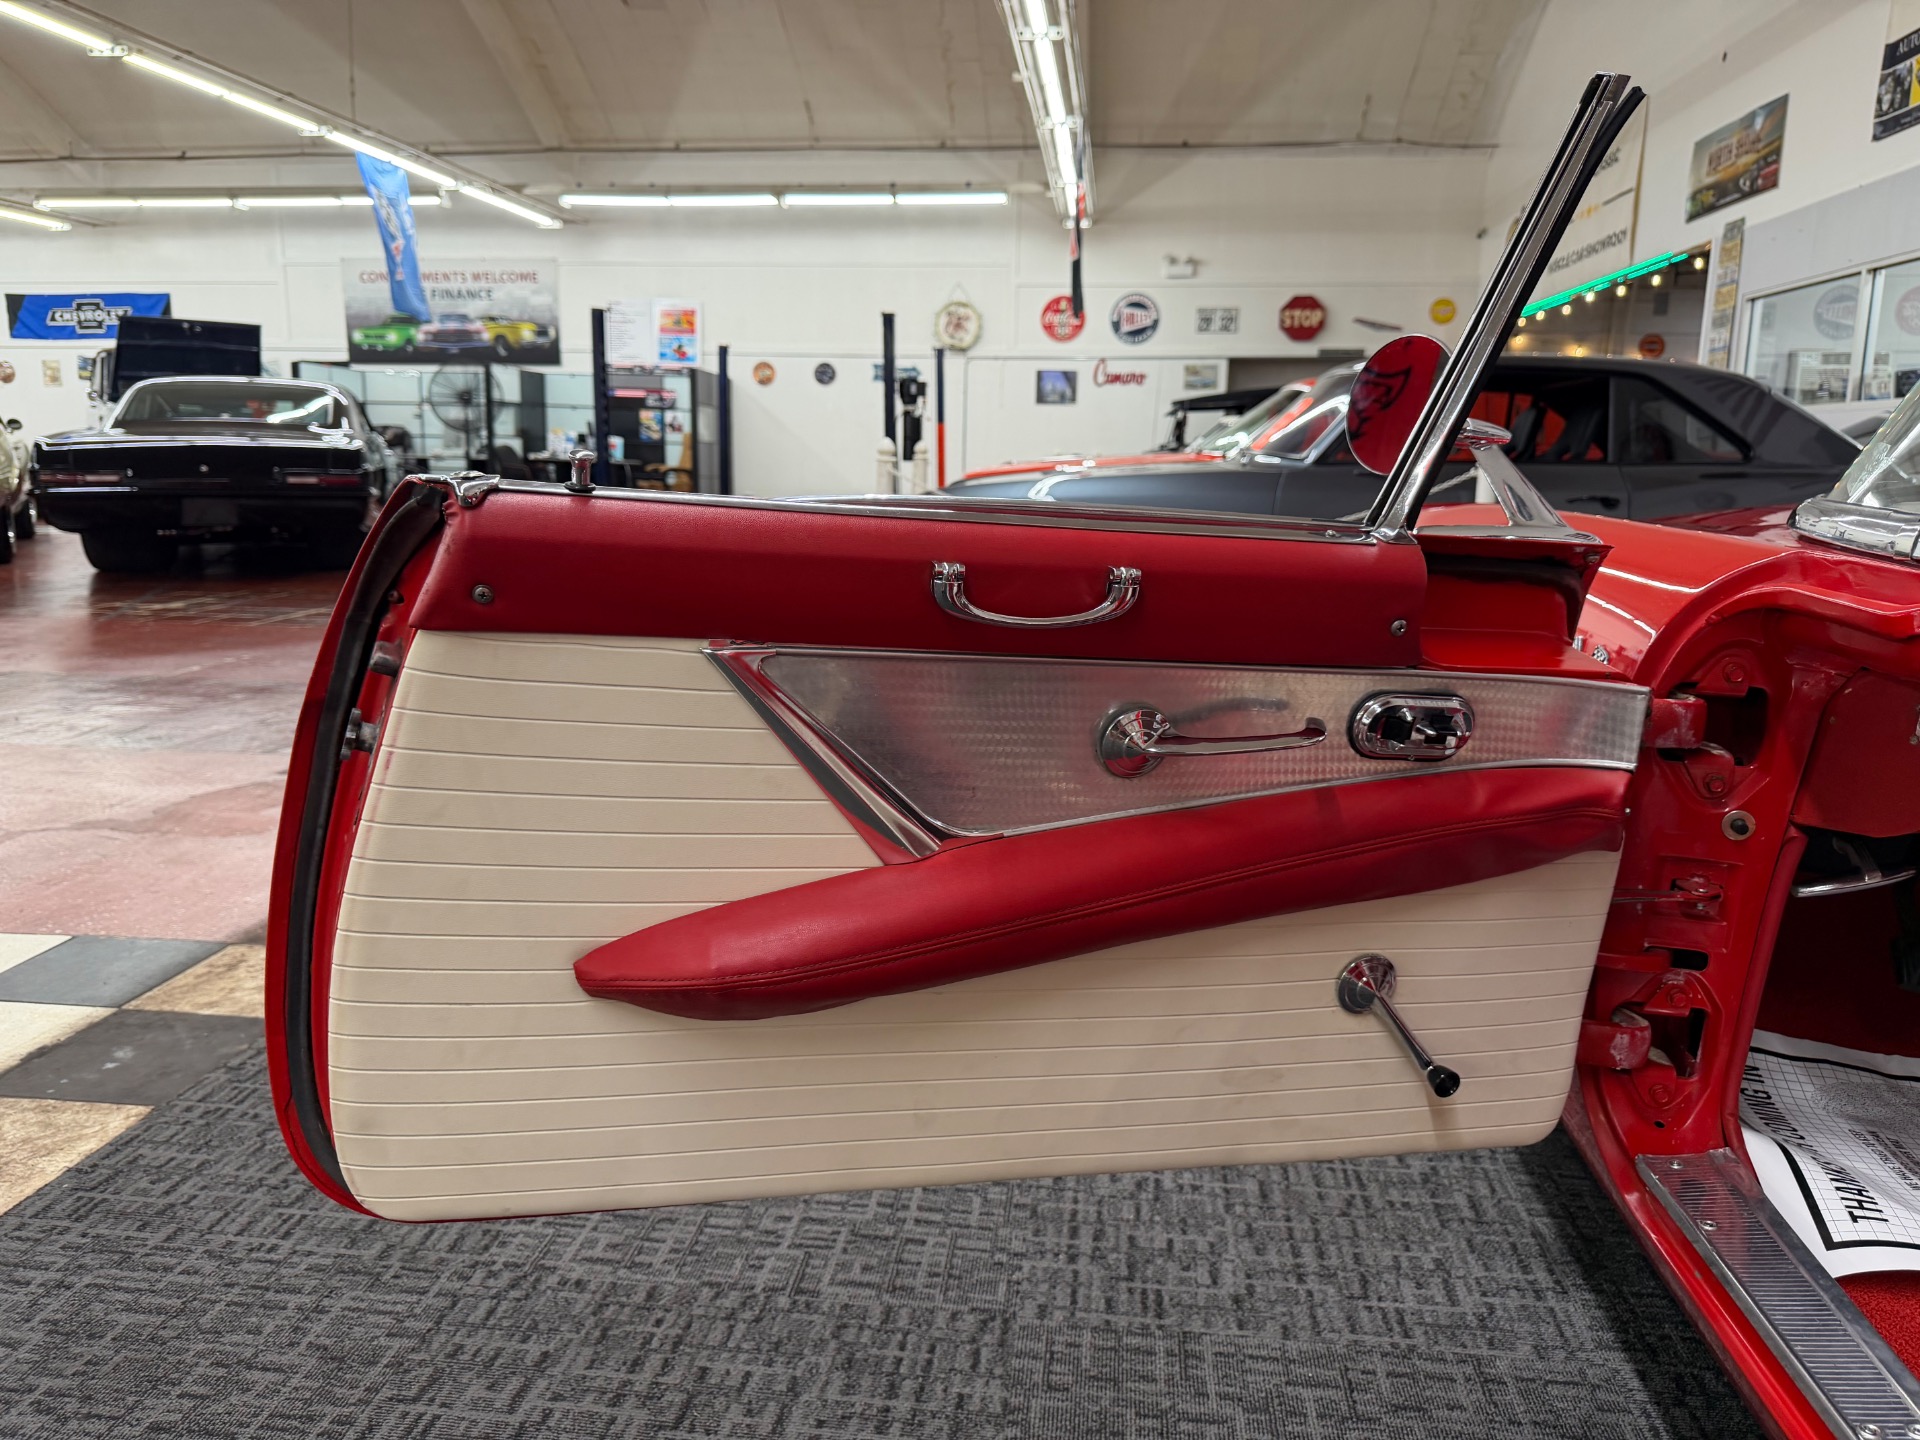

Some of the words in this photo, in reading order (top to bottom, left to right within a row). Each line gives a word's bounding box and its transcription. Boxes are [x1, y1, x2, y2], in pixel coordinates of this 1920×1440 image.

[472, 271, 539, 284] WELCOME
[431, 287, 494, 301] FINANCE
[54, 308, 126, 323] CHEVROLET
[1281, 308, 1324, 328] STOP
[1093, 358, 1146, 387] Camaro
[1742, 1065, 1765, 1084] IN
[1740, 1087, 1806, 1141] COMING
